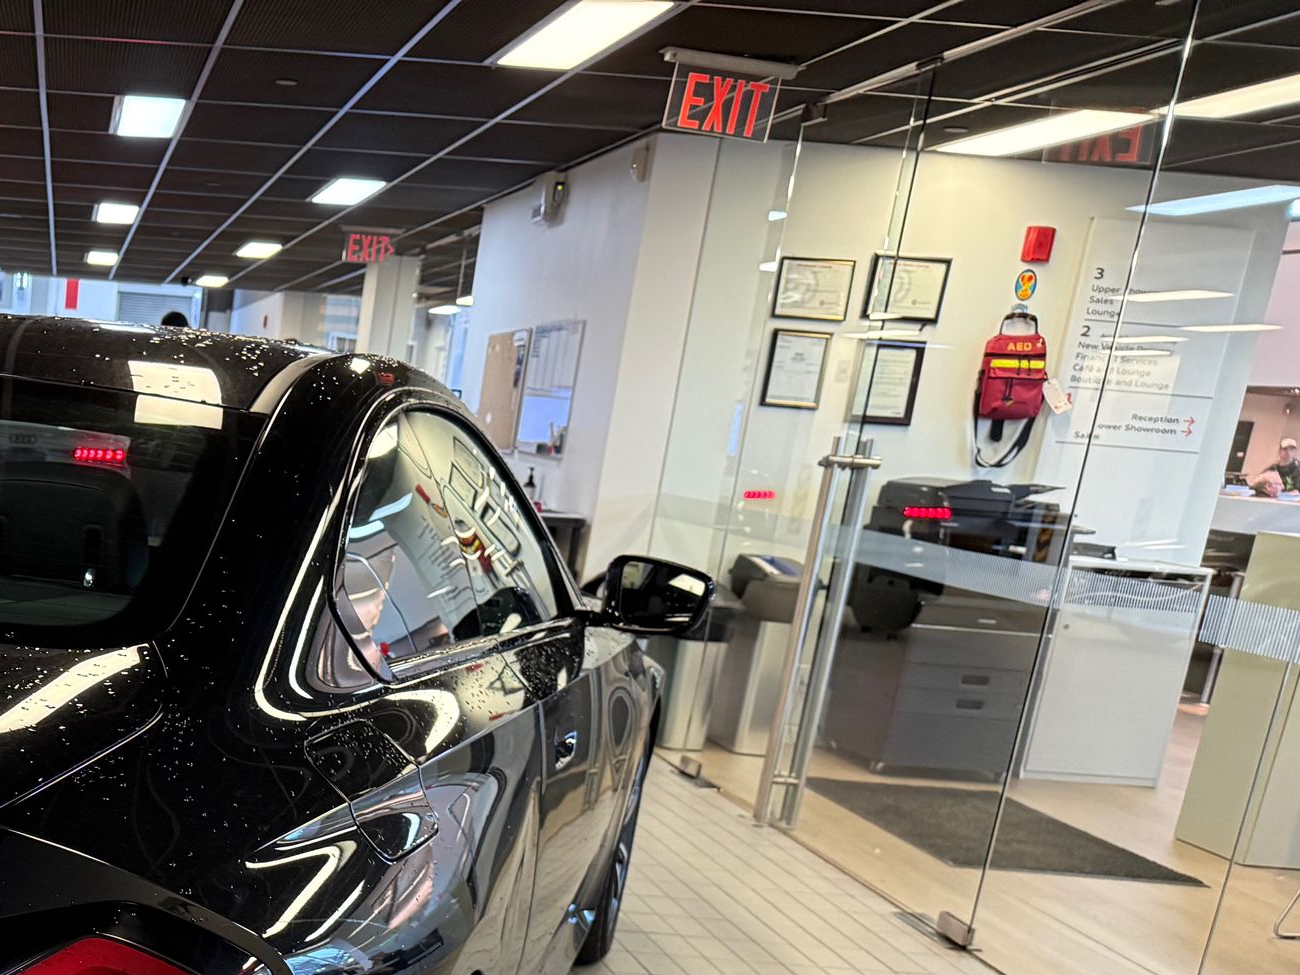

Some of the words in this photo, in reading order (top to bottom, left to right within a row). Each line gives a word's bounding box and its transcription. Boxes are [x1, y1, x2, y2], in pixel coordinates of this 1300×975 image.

[677, 72, 770, 137] EXIT
[347, 233, 390, 263] EXIT
[1093, 267, 1105, 280] 3
[1091, 284, 1121, 294] Upper
[1089, 296, 1114, 305] Sales
[1080, 325, 1091, 337] 2
[1007, 341, 1033, 352] AED
[1077, 341, 1099, 350] New
[1116, 367, 1151, 378] Lounge
[1070, 375, 1113, 386] Boutiqe
[1115, 378, 1133, 387] and
[1134, 380, 1170, 390] Lounge
[1131, 413, 1180, 425] Reception
[1097, 423, 1122, 431] ower
[1124, 423, 1177, 435] Showroom
